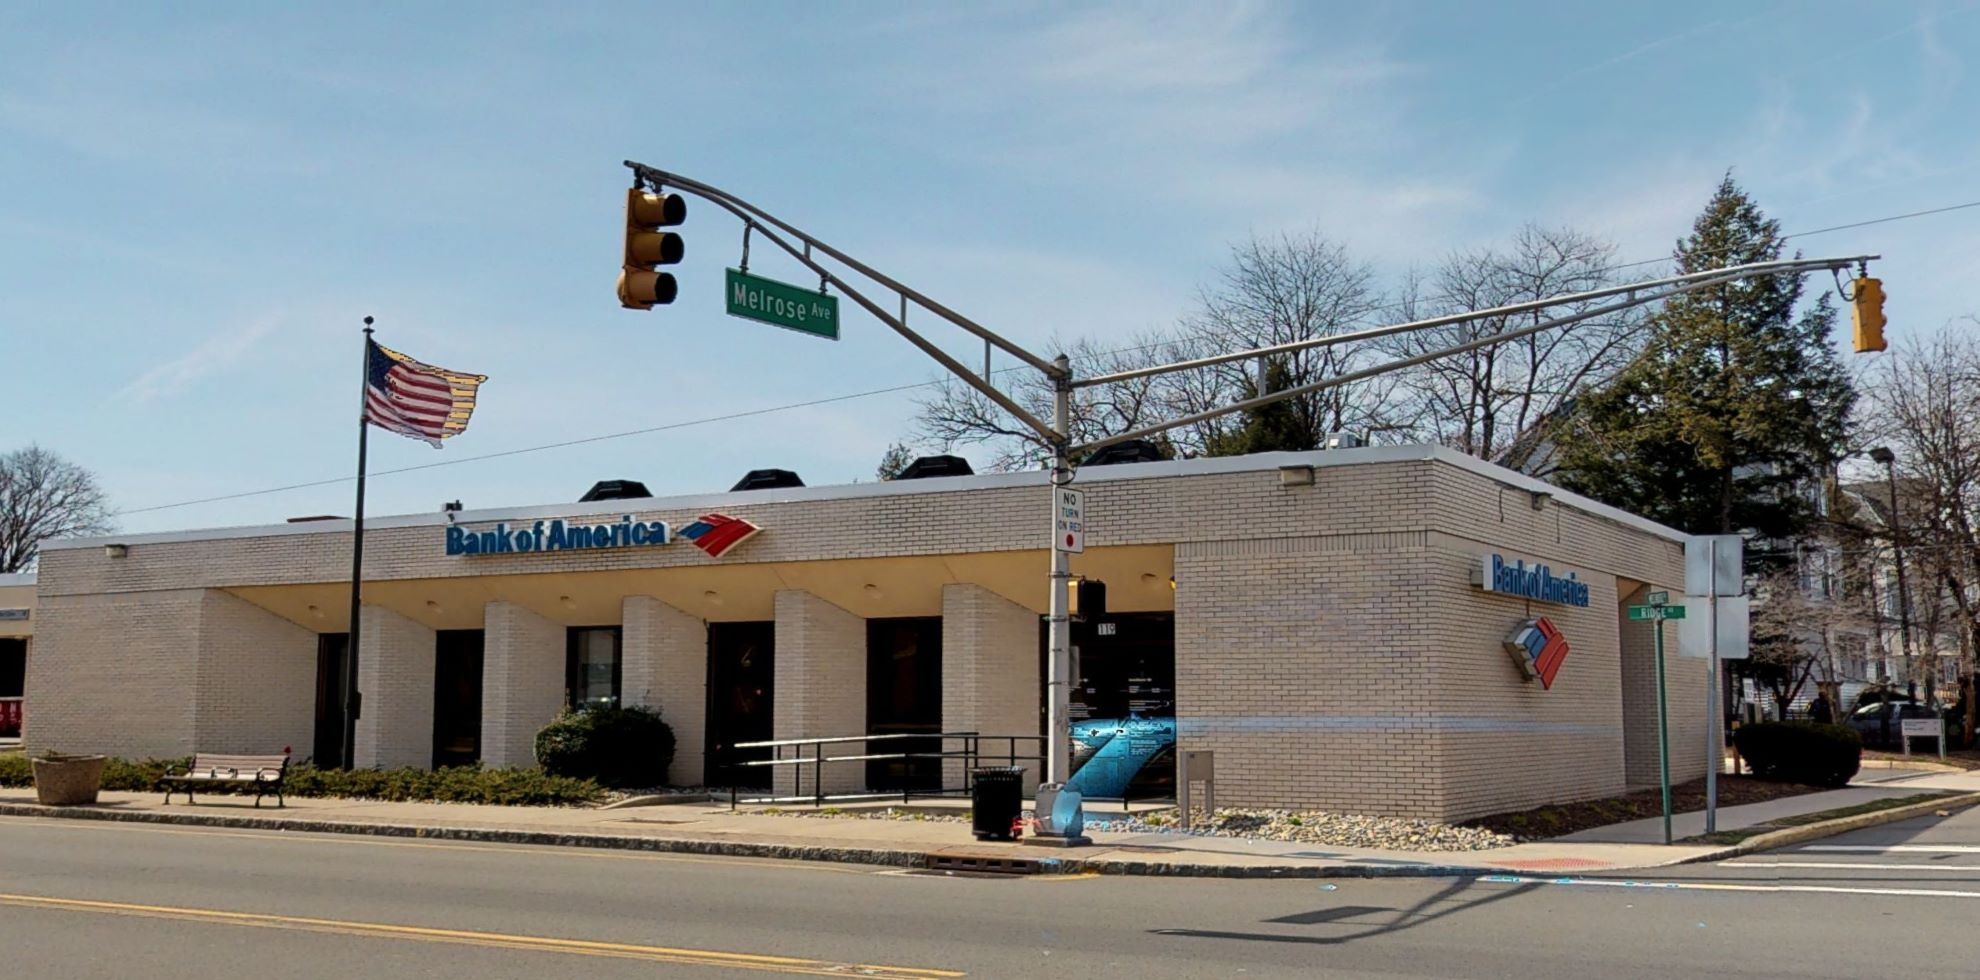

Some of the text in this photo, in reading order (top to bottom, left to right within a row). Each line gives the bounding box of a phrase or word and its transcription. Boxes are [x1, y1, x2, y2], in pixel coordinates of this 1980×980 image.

[734, 282, 830, 320] Melrose Ave
[1063, 492, 1077, 505] NO
[1062, 507, 1079, 518] TURN
[446, 515, 667, 555] Bank of America
[1492, 554, 1589, 607] Bank of America
[1641, 607, 1666, 619] RIDGE
